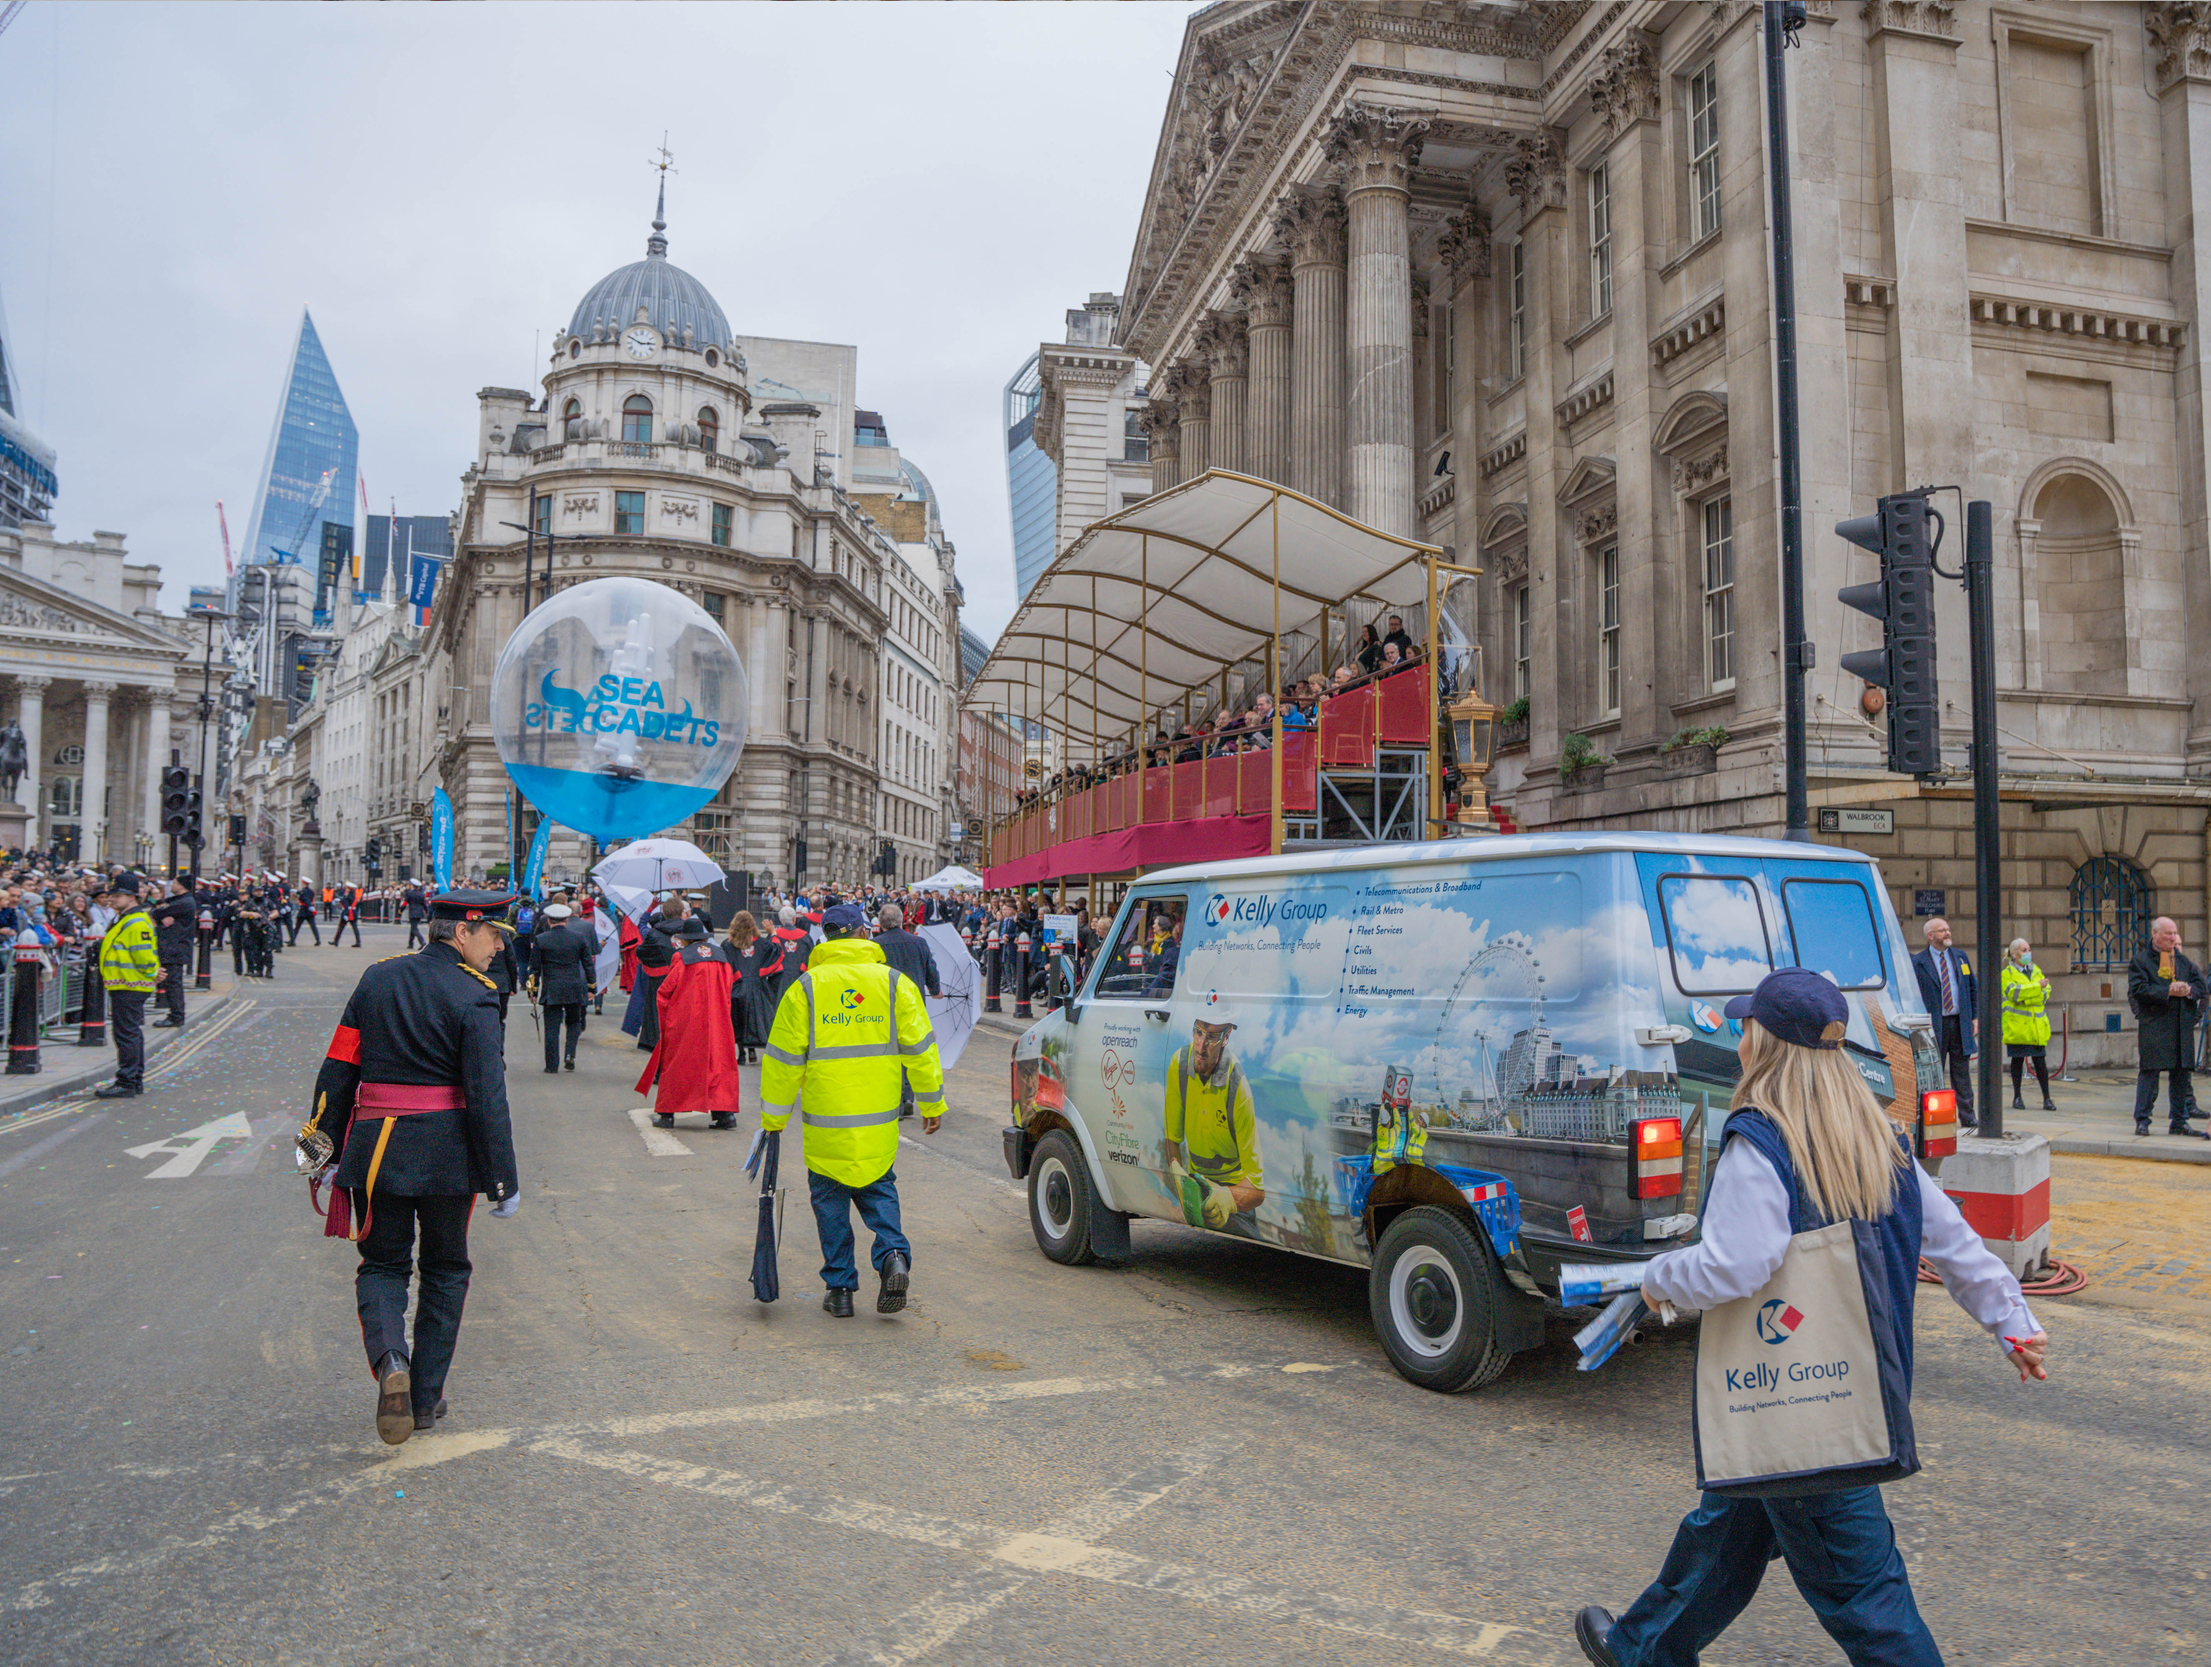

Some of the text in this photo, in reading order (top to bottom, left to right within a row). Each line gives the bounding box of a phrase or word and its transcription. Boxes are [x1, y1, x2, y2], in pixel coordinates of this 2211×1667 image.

[598, 674, 665, 710] SEA
[592, 704, 720, 748] CADETS
[1846, 813, 1886, 822] WALBROOK
[1873, 822, 1886, 830] EC4
[1364, 880, 1482, 897] Telecommunications & Broadband
[1233, 894, 1328, 929] Kelly Group
[1360, 905, 1404, 916] Rail & Metro
[1356, 925, 1403, 936] Fleet Services
[1198, 938, 1321, 954] Building Networks, Connecting People
[1353, 944, 1372, 955] Civils
[1350, 965, 1377, 975] Utilities
[1348, 984, 1415, 999] Traffic Management
[1344, 1004, 1368, 1019] Energy
[822, 1012, 884, 1027] Kelly Group
[1103, 1022, 1118, 1032] Proudly
[1118, 1024, 1132, 1034] working
[1102, 1035, 1138, 1048] openreach
[1858, 1061, 1886, 1085] Centre
[1105, 1130, 1140, 1150] CityFibre
[1107, 1149, 1138, 1166] verizon
[1725, 1360, 1849, 1393] Kelly Group
[1729, 1389, 1852, 1413] Building Networks, Connecting People
